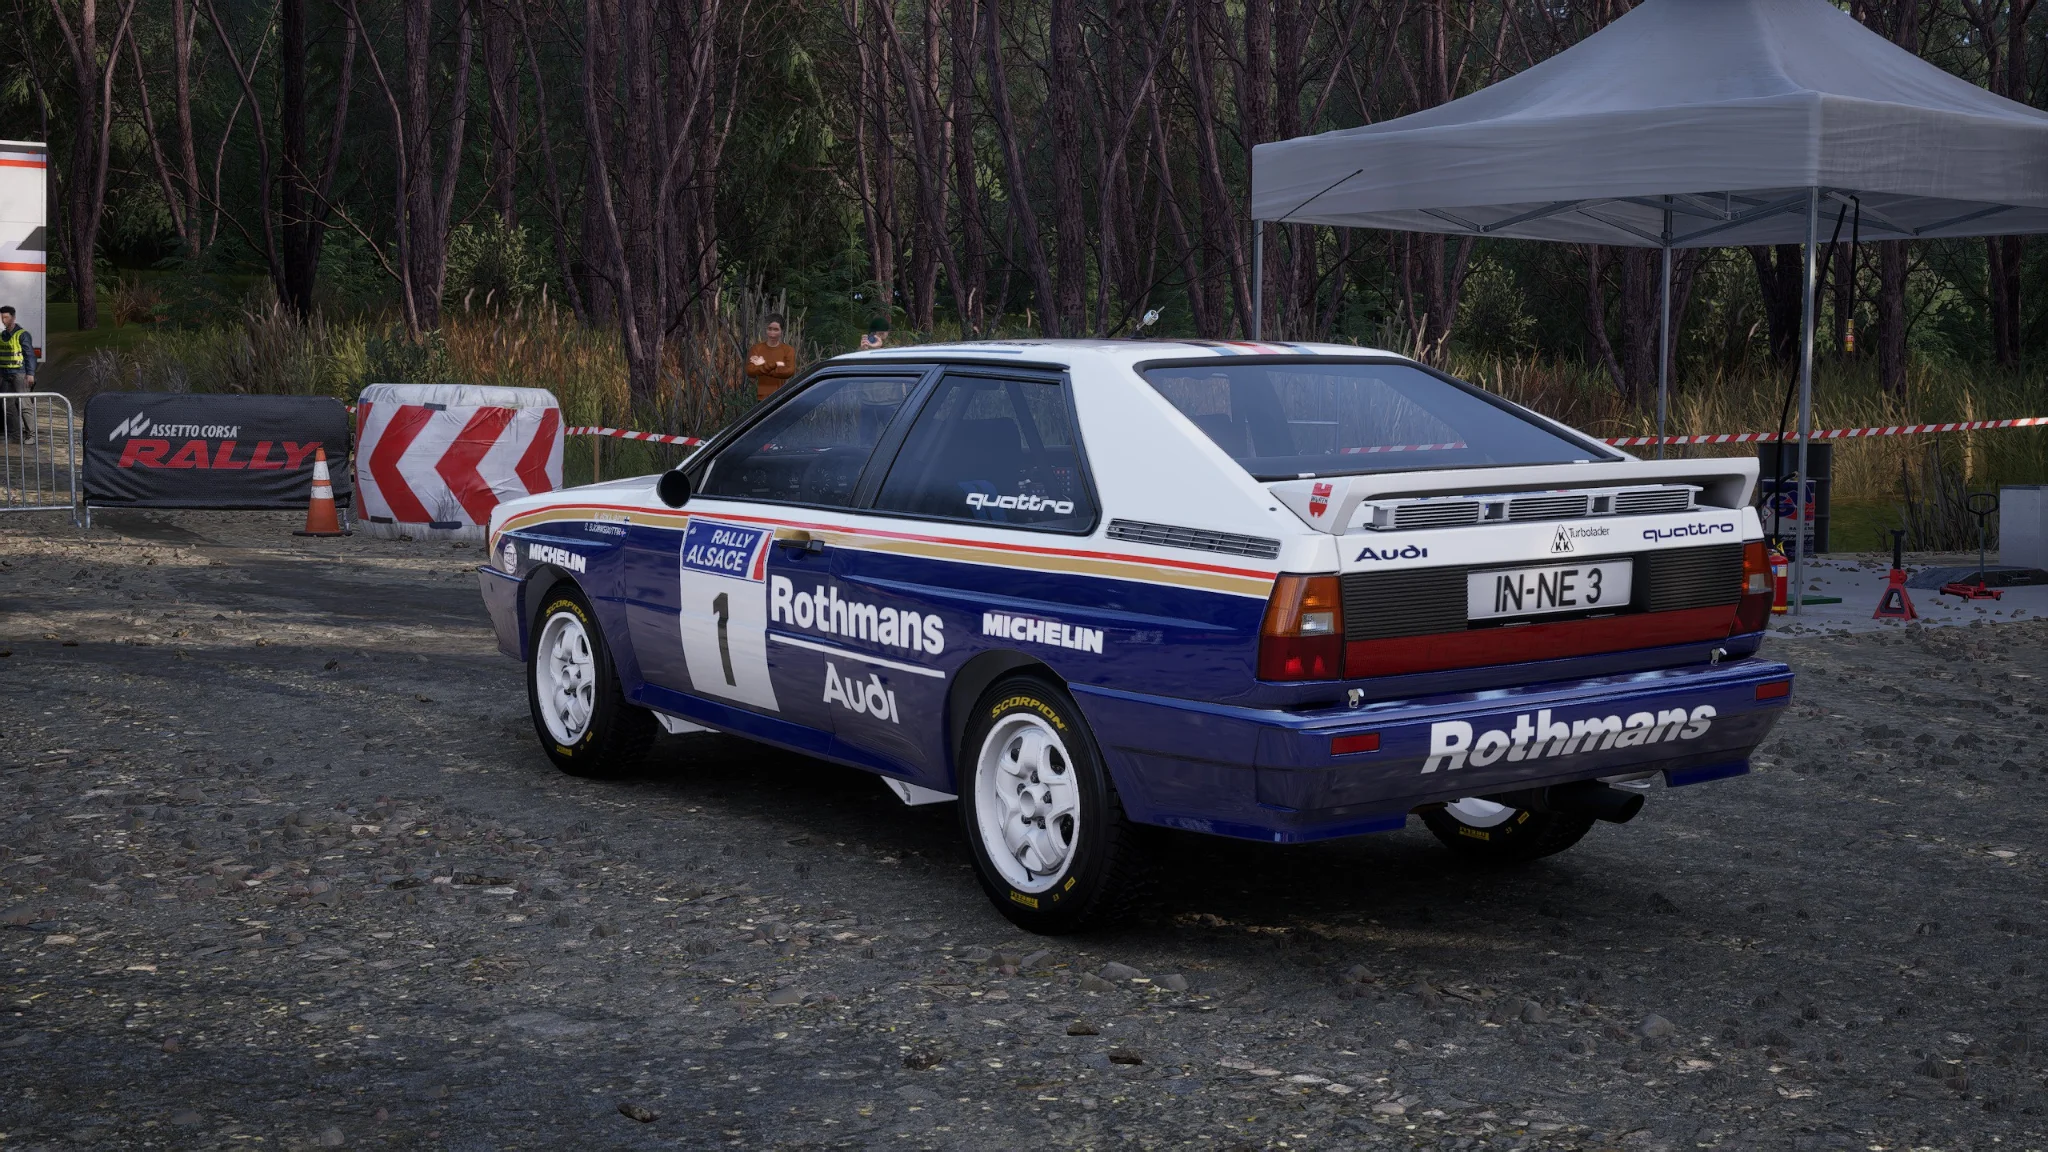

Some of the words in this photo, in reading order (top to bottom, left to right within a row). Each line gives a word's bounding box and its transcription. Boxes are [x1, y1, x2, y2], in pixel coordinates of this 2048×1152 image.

[149, 424, 199, 437] ASSETTO
[201, 425, 237, 437] CORSA
[117, 439, 323, 470] RALLY
[966, 492, 1074, 514] quattro
[711, 529, 755, 549] RALLY
[1568, 526, 1610, 538] Turbolader
[1643, 523, 1734, 543] quattro
[529, 543, 586, 574] MICHELIN
[686, 544, 747, 572] ALSACE
[1354, 545, 1427, 562] Audi
[1494, 569, 1579, 613] IN-NE
[1586, 568, 1603, 604] 3
[546, 599, 588, 623] SCORPION
[770, 574, 945, 655] Rothmans
[712, 592, 737, 687] 1
[982, 613, 1104, 654] MICHELIN
[823, 662, 900, 724] Audi
[992, 696, 1066, 730] SCORPION
[1420, 704, 1717, 775] Rothmans
